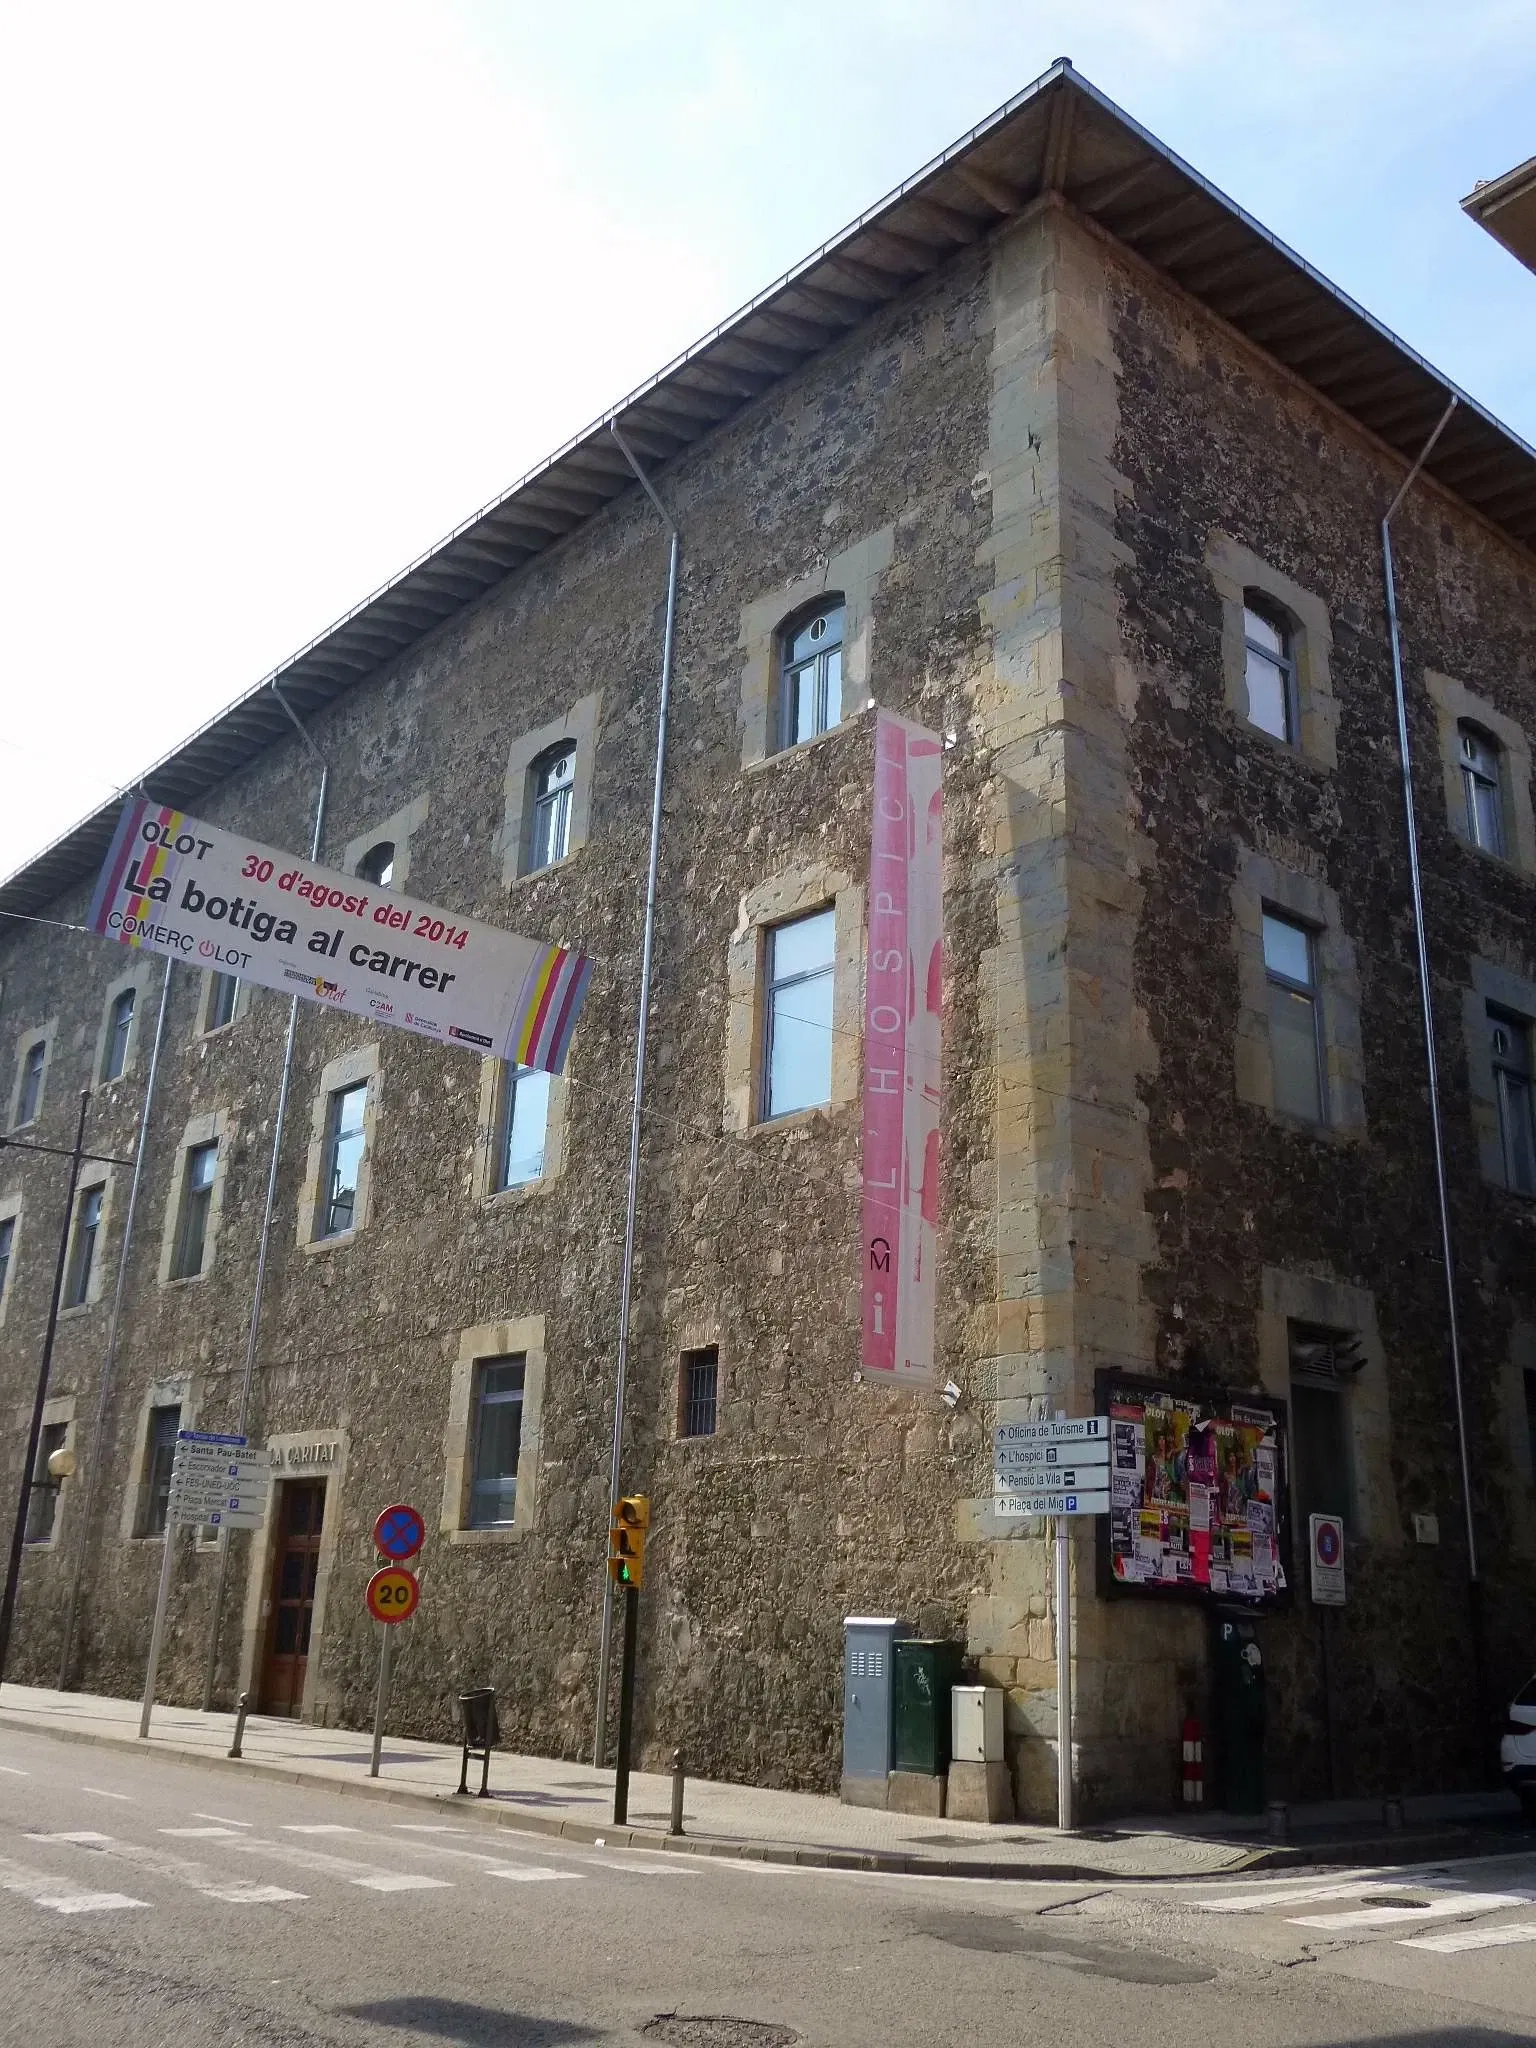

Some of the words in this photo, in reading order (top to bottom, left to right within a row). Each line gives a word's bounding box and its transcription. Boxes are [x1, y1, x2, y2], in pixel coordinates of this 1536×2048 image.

[142, 821, 214, 860] OLOT
[241, 855, 274, 883] 30
[278, 870, 369, 917] d'agost
[373, 904, 412, 931] del
[413, 915, 470, 950] 2014
[108, 911, 195, 954] COMERÇ
[124, 860, 172, 903] La
[180, 879, 298, 943] botiga
[307, 929, 345, 958] al
[349, 944, 456, 993] carrer
[1008, 1425, 1036, 1439] Oficina
[1039, 1425, 1048, 1437] de
[1051, 1423, 1084, 1436] Turisme
[190, 1445, 213, 1455] Santa
[287, 1442, 337, 1464] CARITAT
[1008, 1449, 1043, 1464] L'hospici
[1008, 1473, 1034, 1487] Pensió
[1036, 1473, 1044, 1486] la
[1046, 1472, 1060, 1485] Vila
[1008, 1498, 1032, 1512] Plaça
[1034, 1497, 1046, 1510] del
[1049, 1497, 1064, 1512] Mig
[379, 1585, 409, 1604] 20
[1223, 1624, 1232, 1640] P
